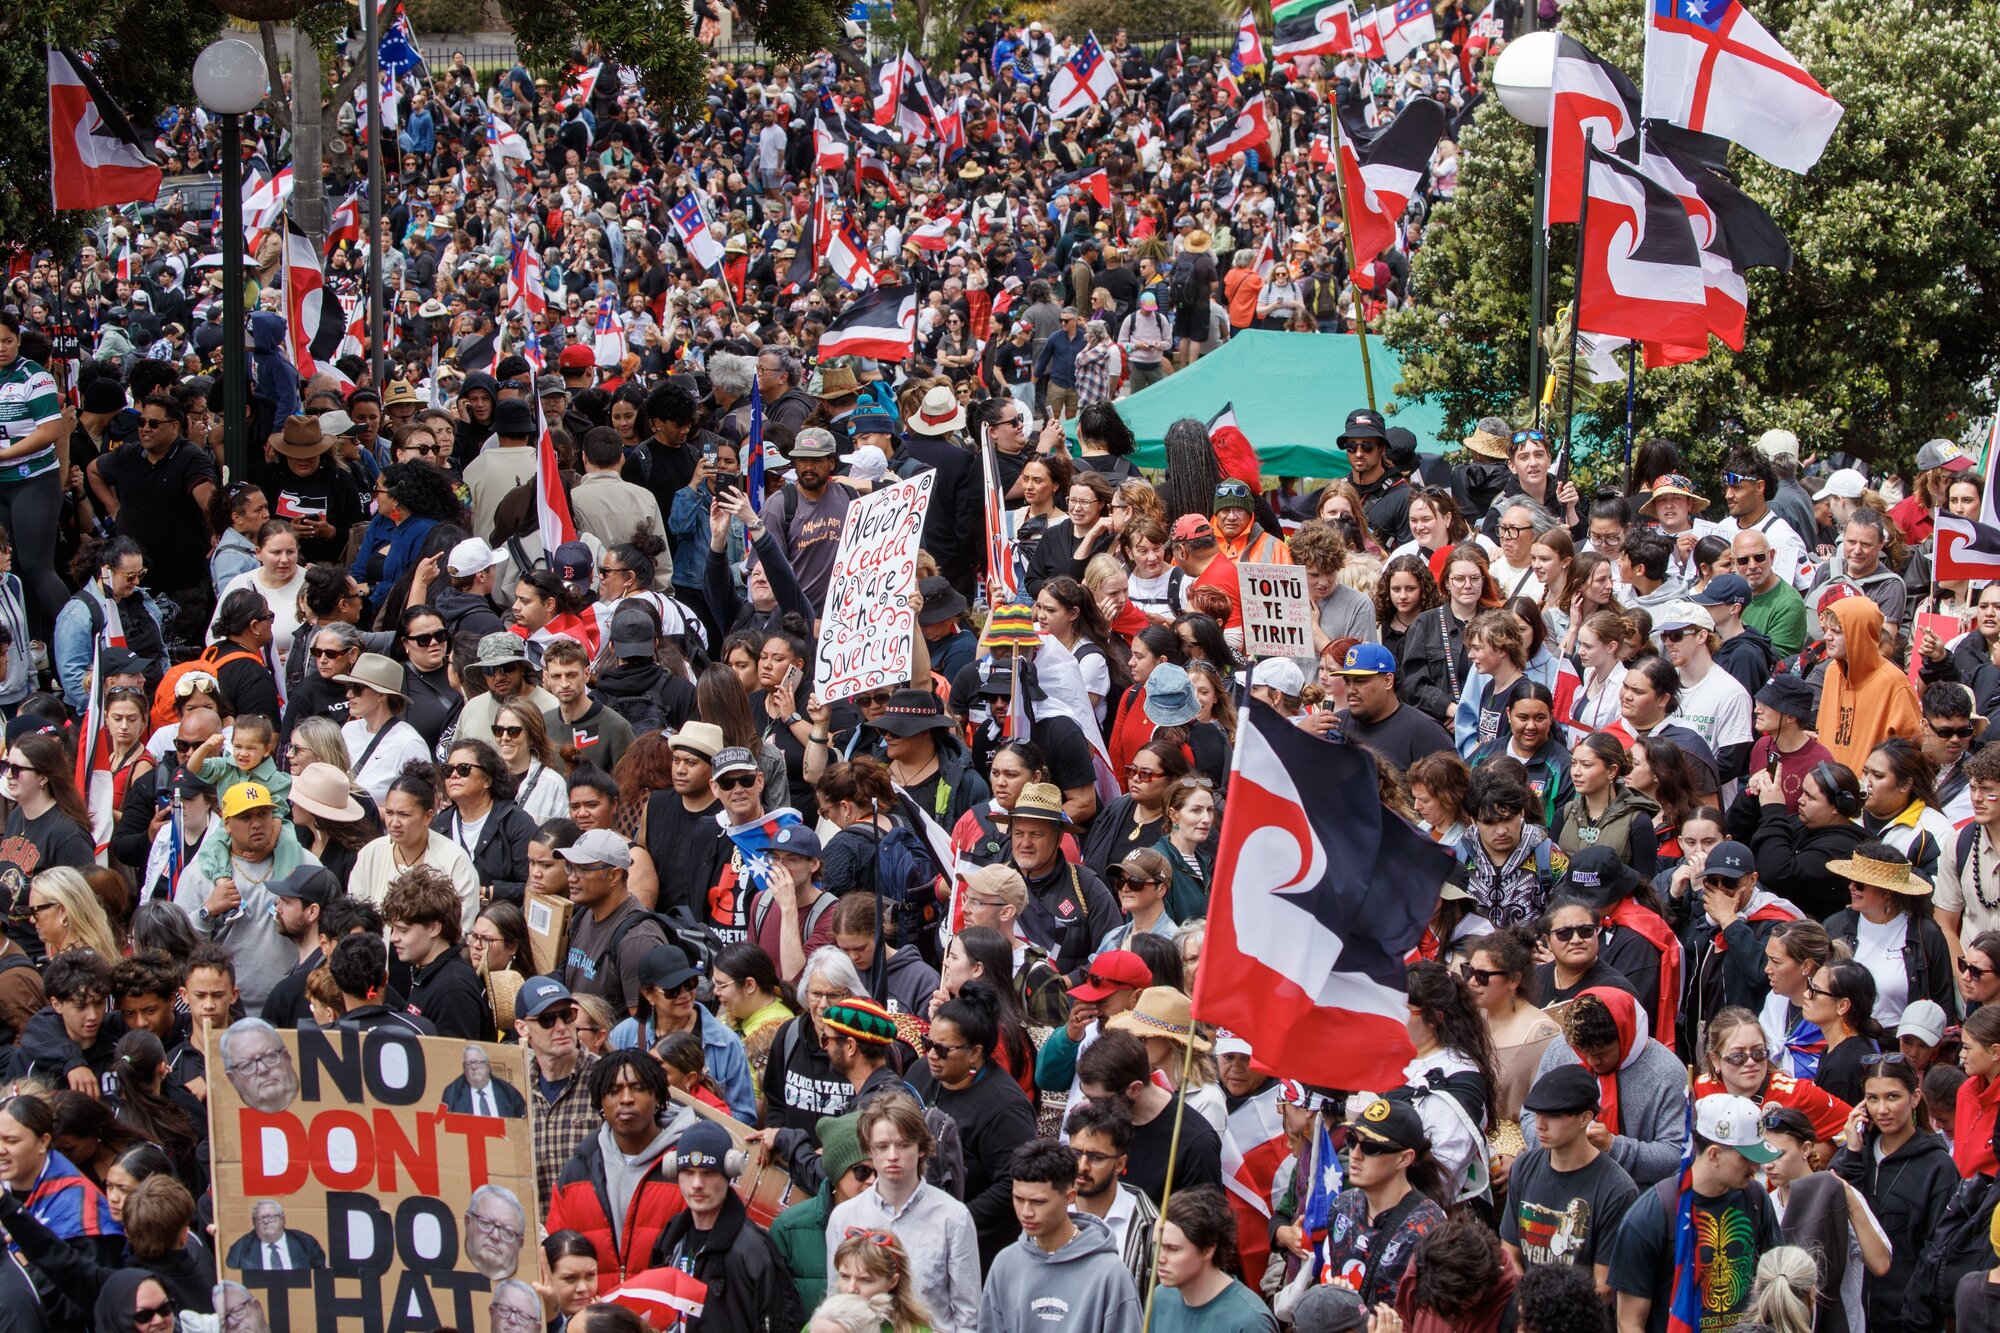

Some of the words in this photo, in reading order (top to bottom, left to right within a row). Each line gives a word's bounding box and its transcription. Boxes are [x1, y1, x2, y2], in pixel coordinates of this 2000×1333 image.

[846, 503, 908, 552] Never
[563, 565, 575, 579] B
[847, 535, 907, 576] Ceded
[832, 578, 855, 612] We
[866, 570, 897, 598] are
[1248, 578, 1302, 600] TOITŪ
[1842, 584, 1855, 597] LA
[846, 603, 878, 632] the
[1263, 601, 1283, 620] TE
[1251, 624, 1304, 645] TIRITI
[818, 630, 910, 684] Sovereign
[1692, 715, 1715, 725] DOES
[246, 787, 259, 800] NY
[297, 1018, 427, 1106] NO
[239, 1103, 507, 1197] DON'T
[326, 1191, 459, 1279] DO
[241, 1267, 492, 1333] THAT
